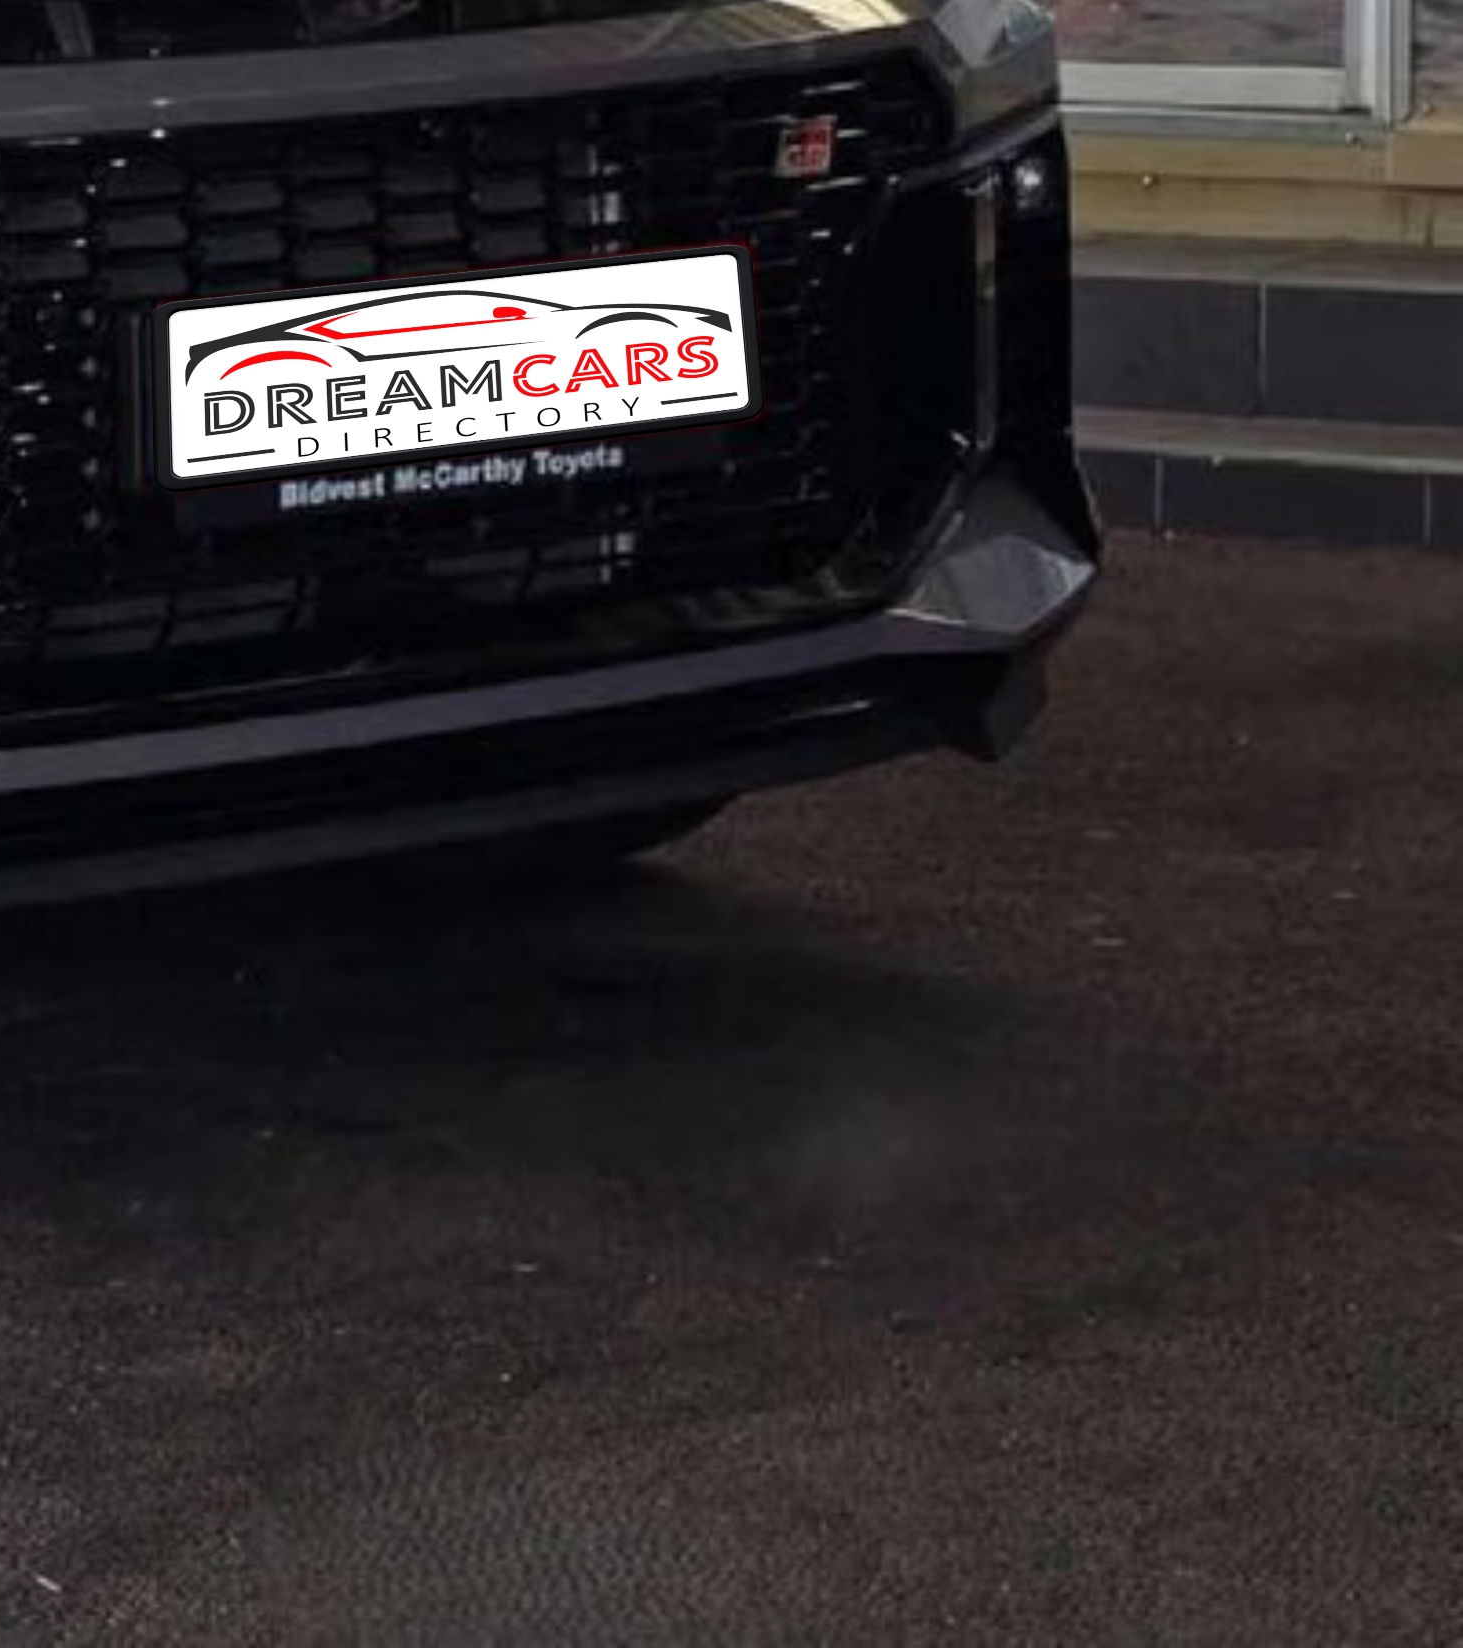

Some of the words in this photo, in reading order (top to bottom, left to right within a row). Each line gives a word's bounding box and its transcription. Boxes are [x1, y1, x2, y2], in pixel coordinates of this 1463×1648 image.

[280, 474, 385, 509] Bidvest
[394, 456, 524, 490] McCarthy
[533, 444, 622, 477] Toyota
